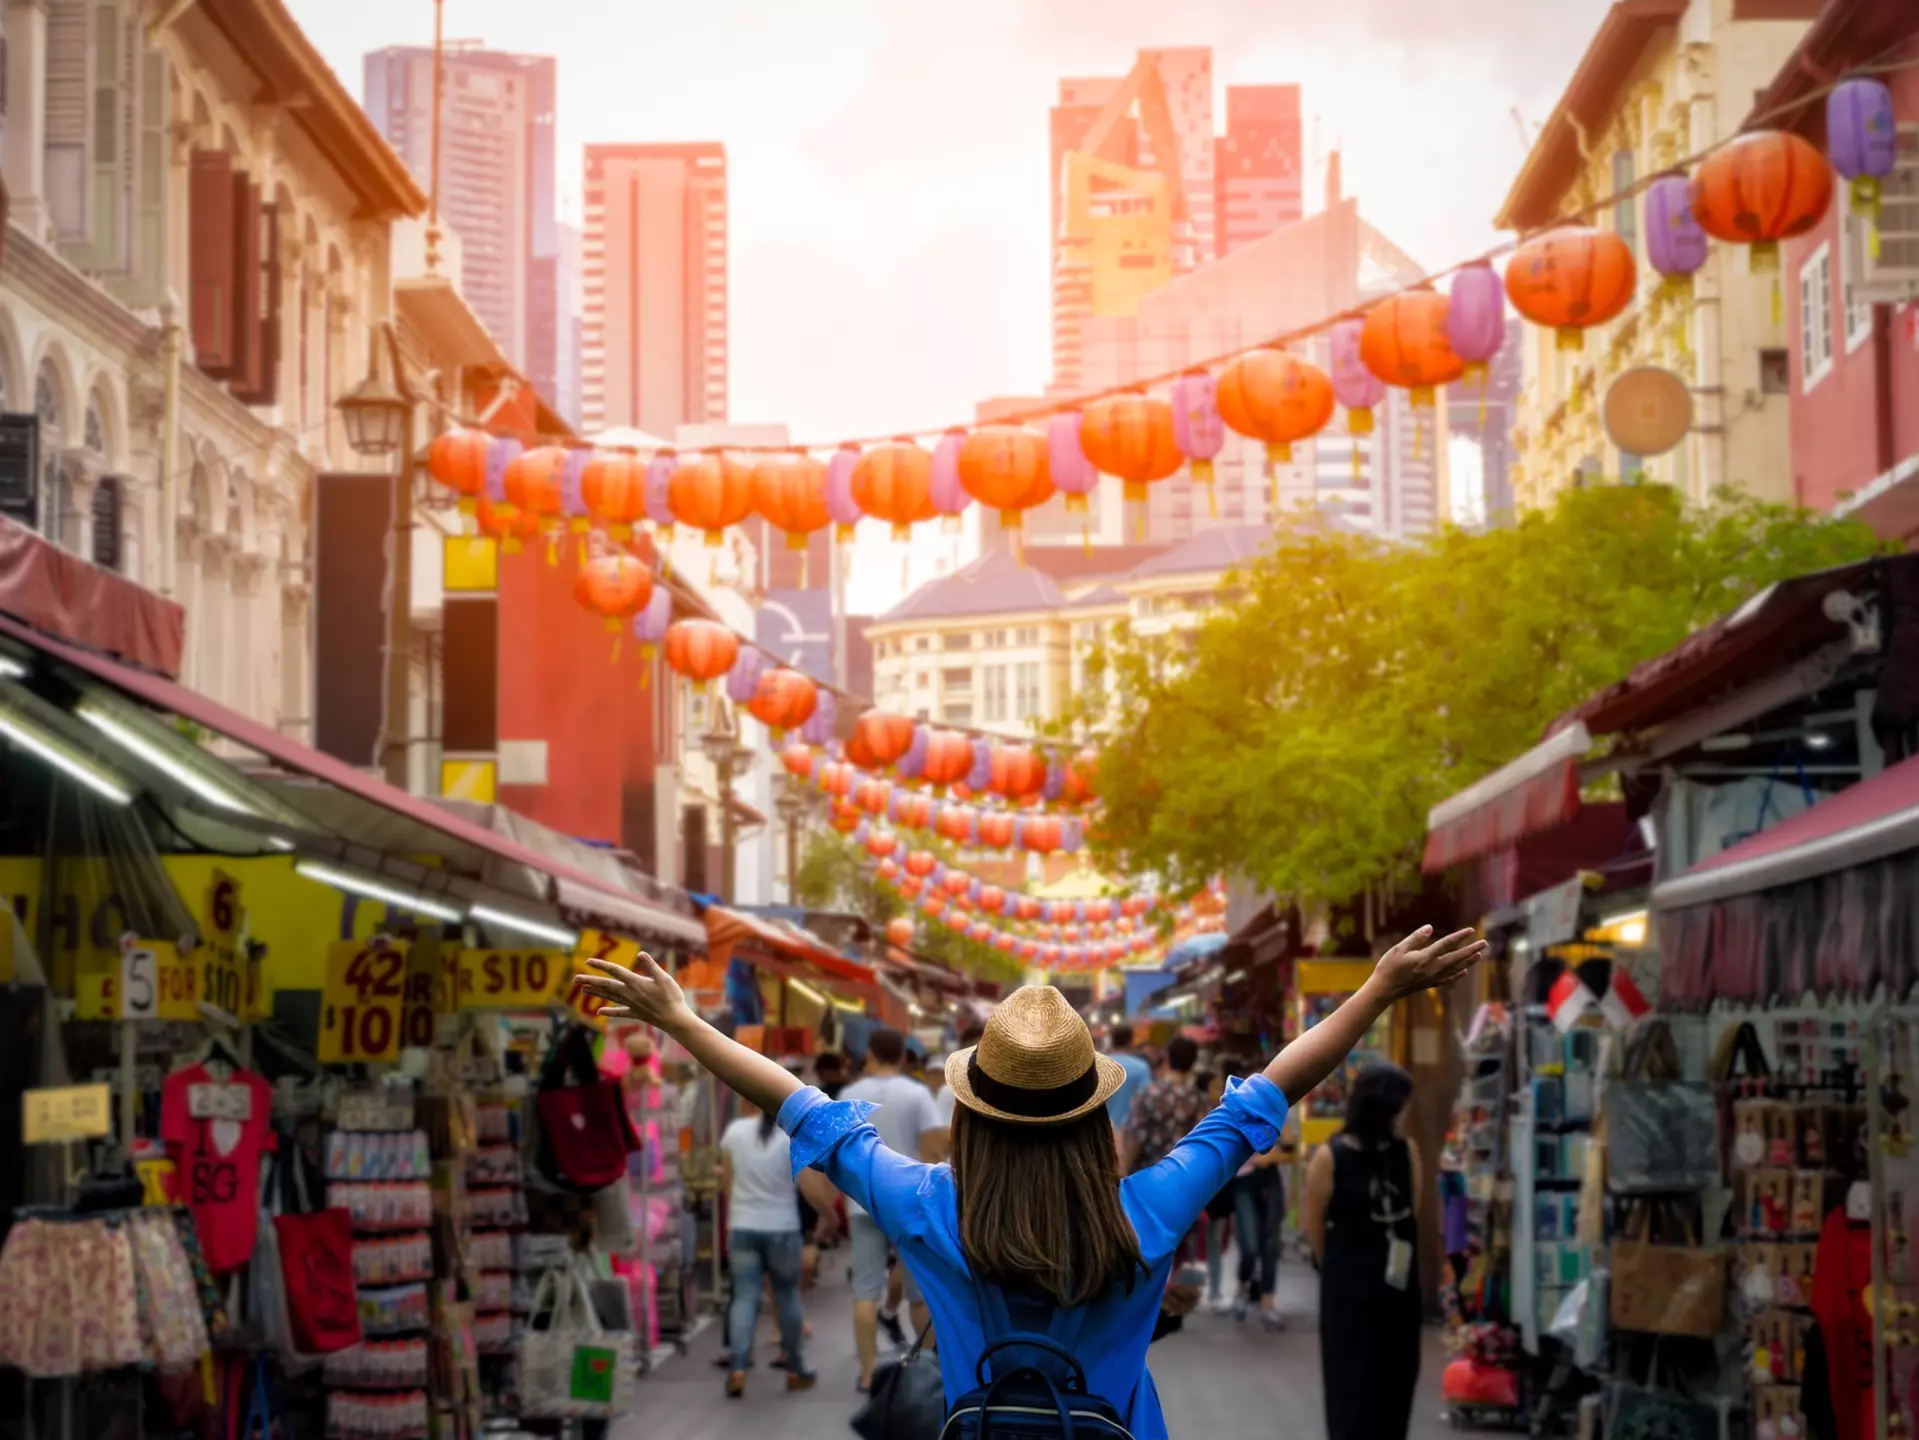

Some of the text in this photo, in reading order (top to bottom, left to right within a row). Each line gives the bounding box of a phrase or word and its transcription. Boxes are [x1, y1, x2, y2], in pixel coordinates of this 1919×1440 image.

[214, 880, 234, 931] 6
[128, 952, 154, 1011] 5
[160, 965, 197, 1002] FOR
[203, 961, 240, 1015] $10
[344, 950, 404, 1003] 42
[483, 954, 549, 994] $10
[325, 1003, 393, 1055] $10
[193, 1162, 239, 1205] SG
